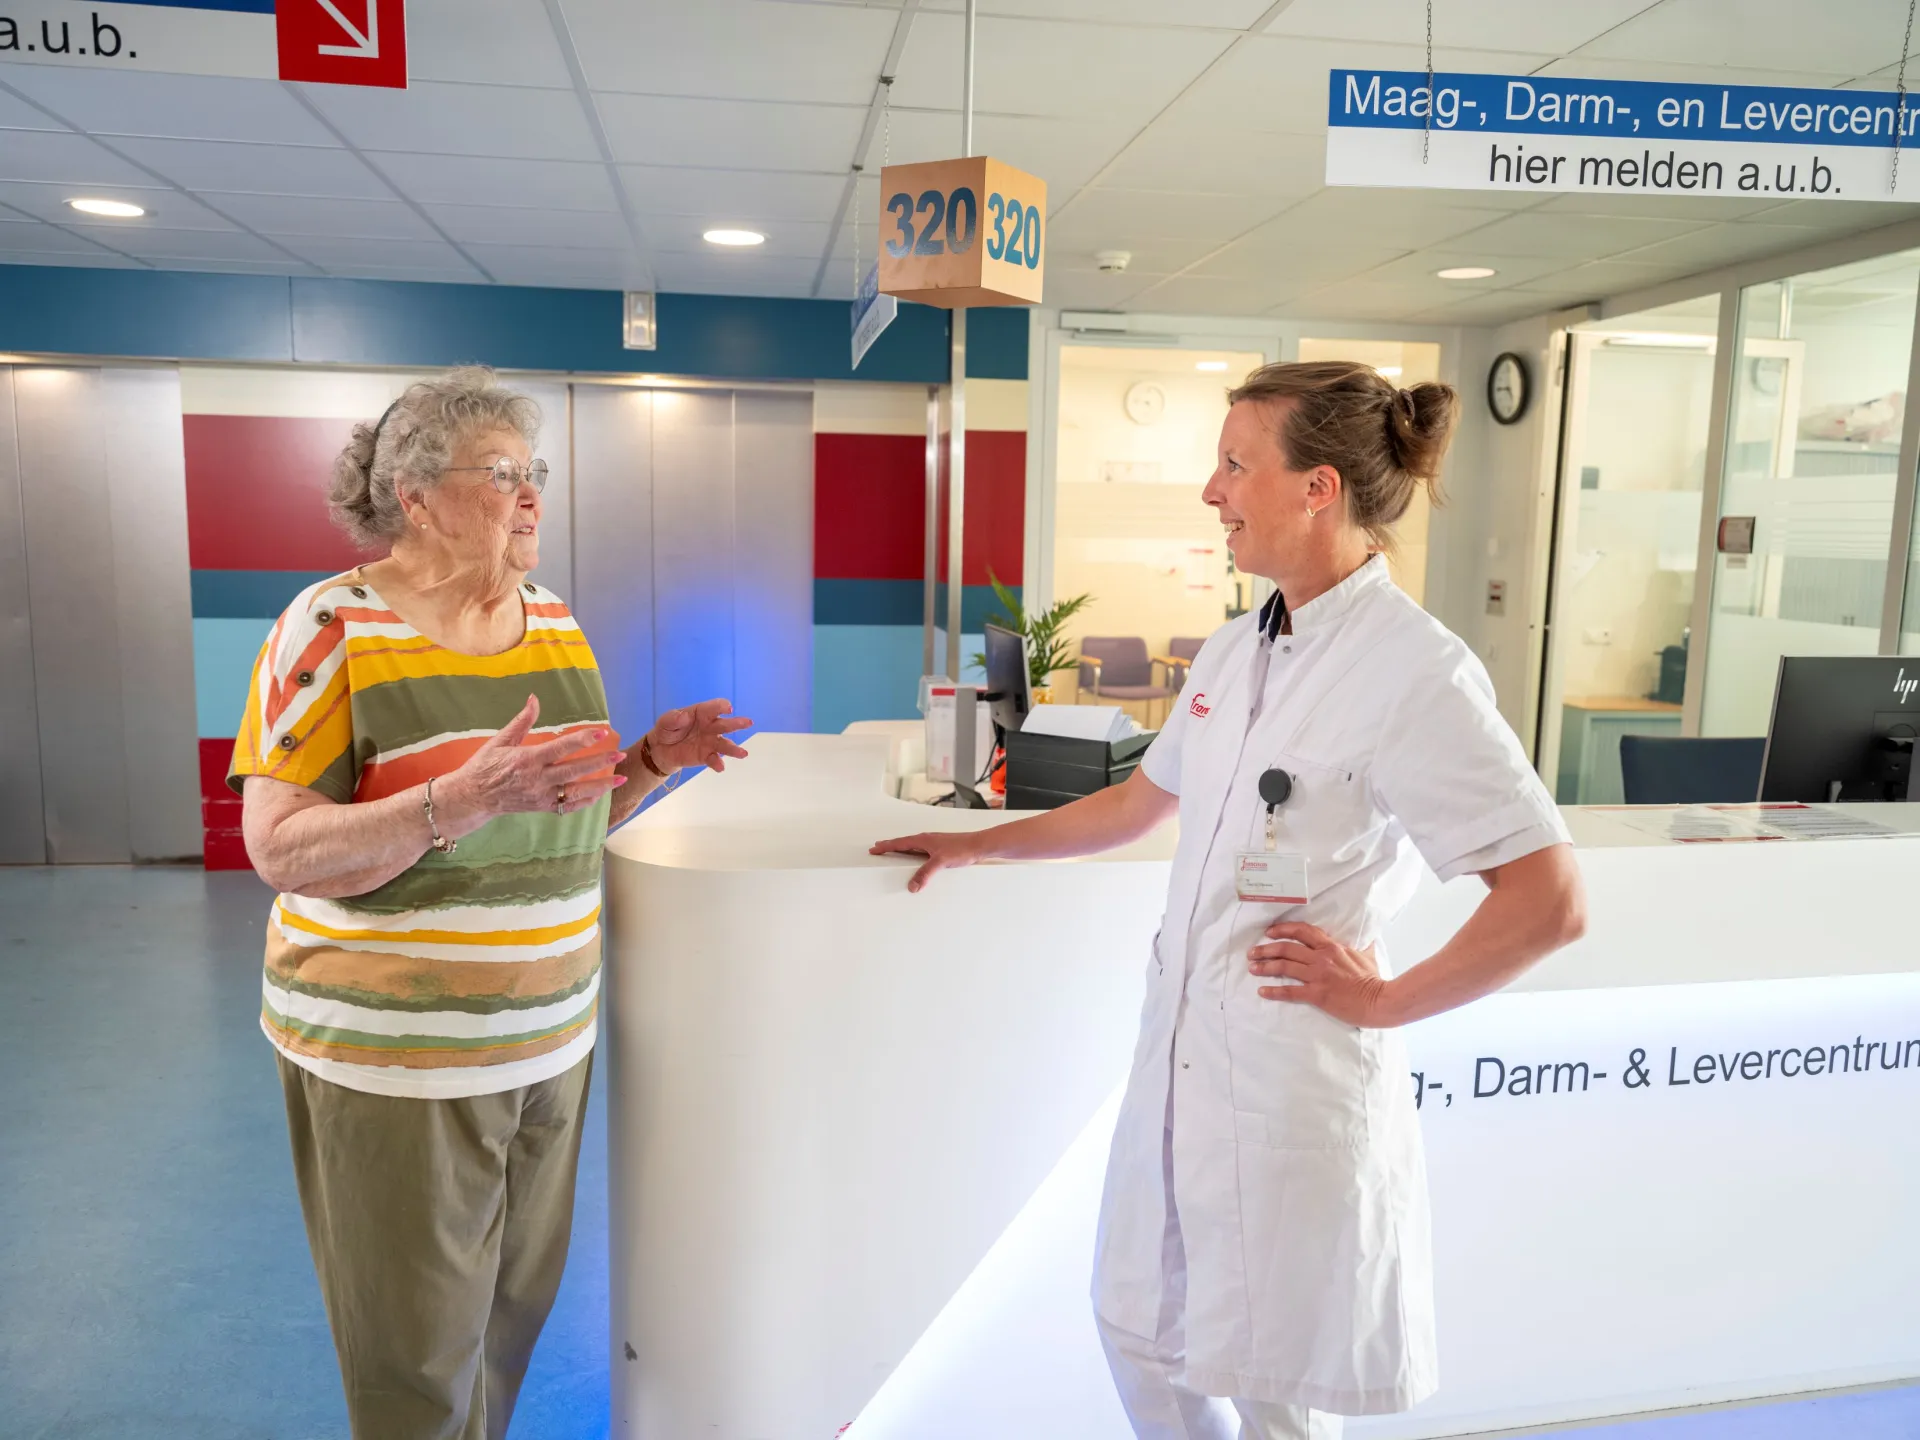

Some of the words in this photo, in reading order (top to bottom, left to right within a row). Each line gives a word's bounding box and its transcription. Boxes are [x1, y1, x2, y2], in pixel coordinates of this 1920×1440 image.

[0, 12, 138, 58] a.u.b.
[1345, 74, 1487, 129] Maag-,
[1505, 81, 1640, 132] Darm-,
[1657, 98, 1705, 128] en
[1489, 144, 1567, 184] hier
[1579, 151, 1723, 190] melden
[1737, 156, 1842, 195] a.u.b.
[885, 186, 977, 259] 320
[986, 192, 1041, 270] 320
[1892, 668, 1919, 701] hp
[1473, 1056, 1608, 1098] Darm-
[1622, 1048, 1651, 1089] &
